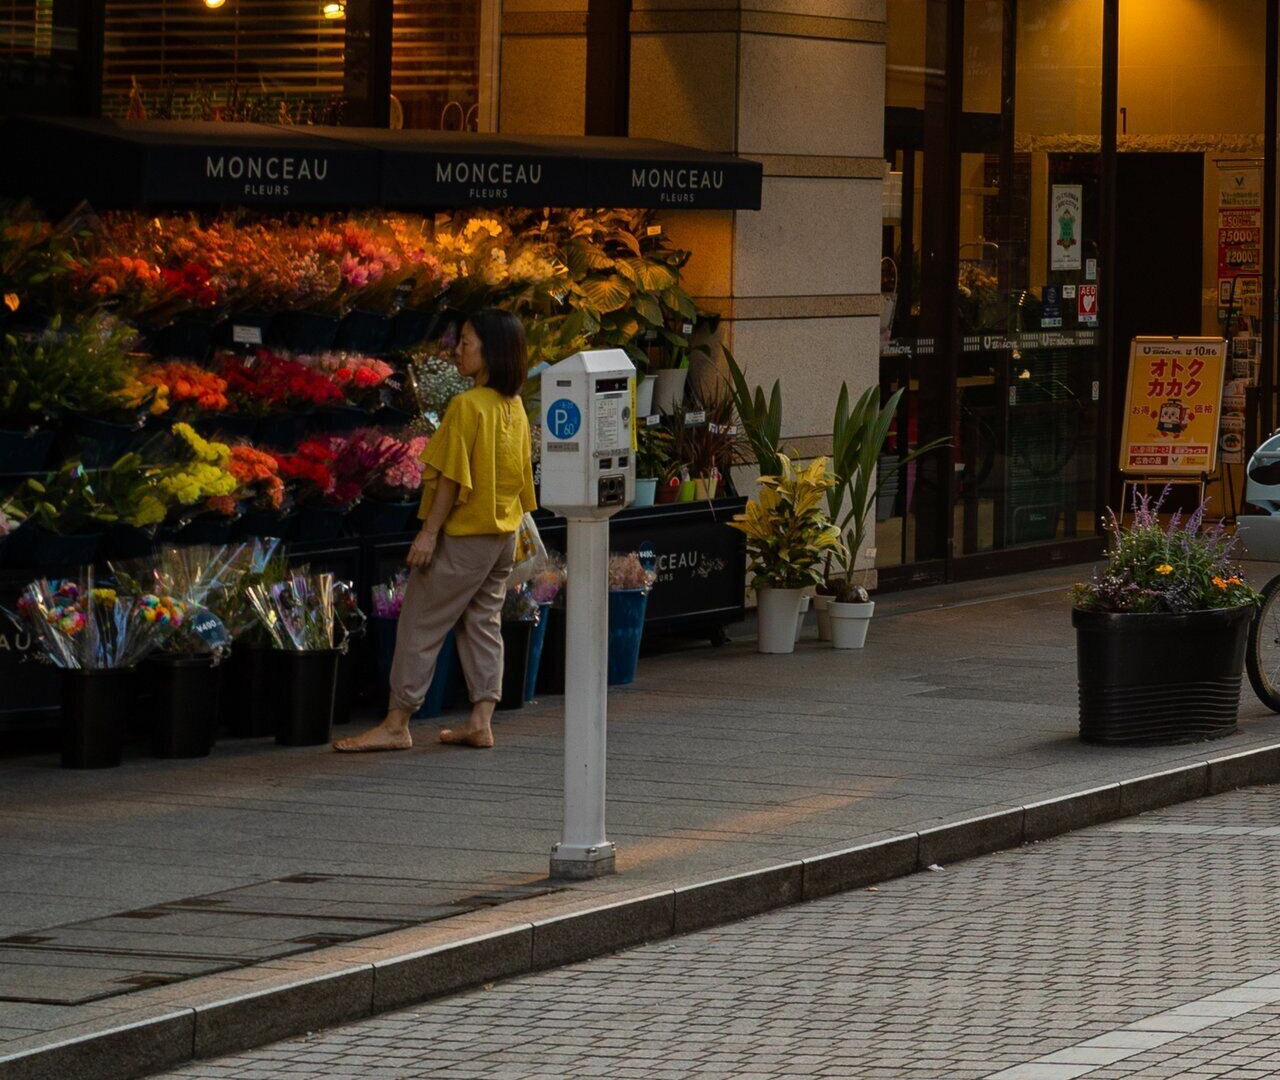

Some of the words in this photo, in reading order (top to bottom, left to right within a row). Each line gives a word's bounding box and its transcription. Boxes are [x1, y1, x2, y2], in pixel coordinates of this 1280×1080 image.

[206, 156, 328, 180] MONCEAU
[436, 162, 542, 184] MONCEAU
[631, 169, 724, 189] MONCEAU
[244, 184, 289, 196] FLEURS
[469, 188, 508, 199] FLEURS
[660, 192, 695, 203] FLEURS
[1080, 286, 1096, 296] AED
[1150, 357, 1205, 378] オトク
[1146, 378, 1202, 398] カカク
[1132, 405, 1151, 416] お得
[1194, 403, 1214, 414] 価格
[555, 409, 569, 435] P
[564, 423, 575, 435] 60
